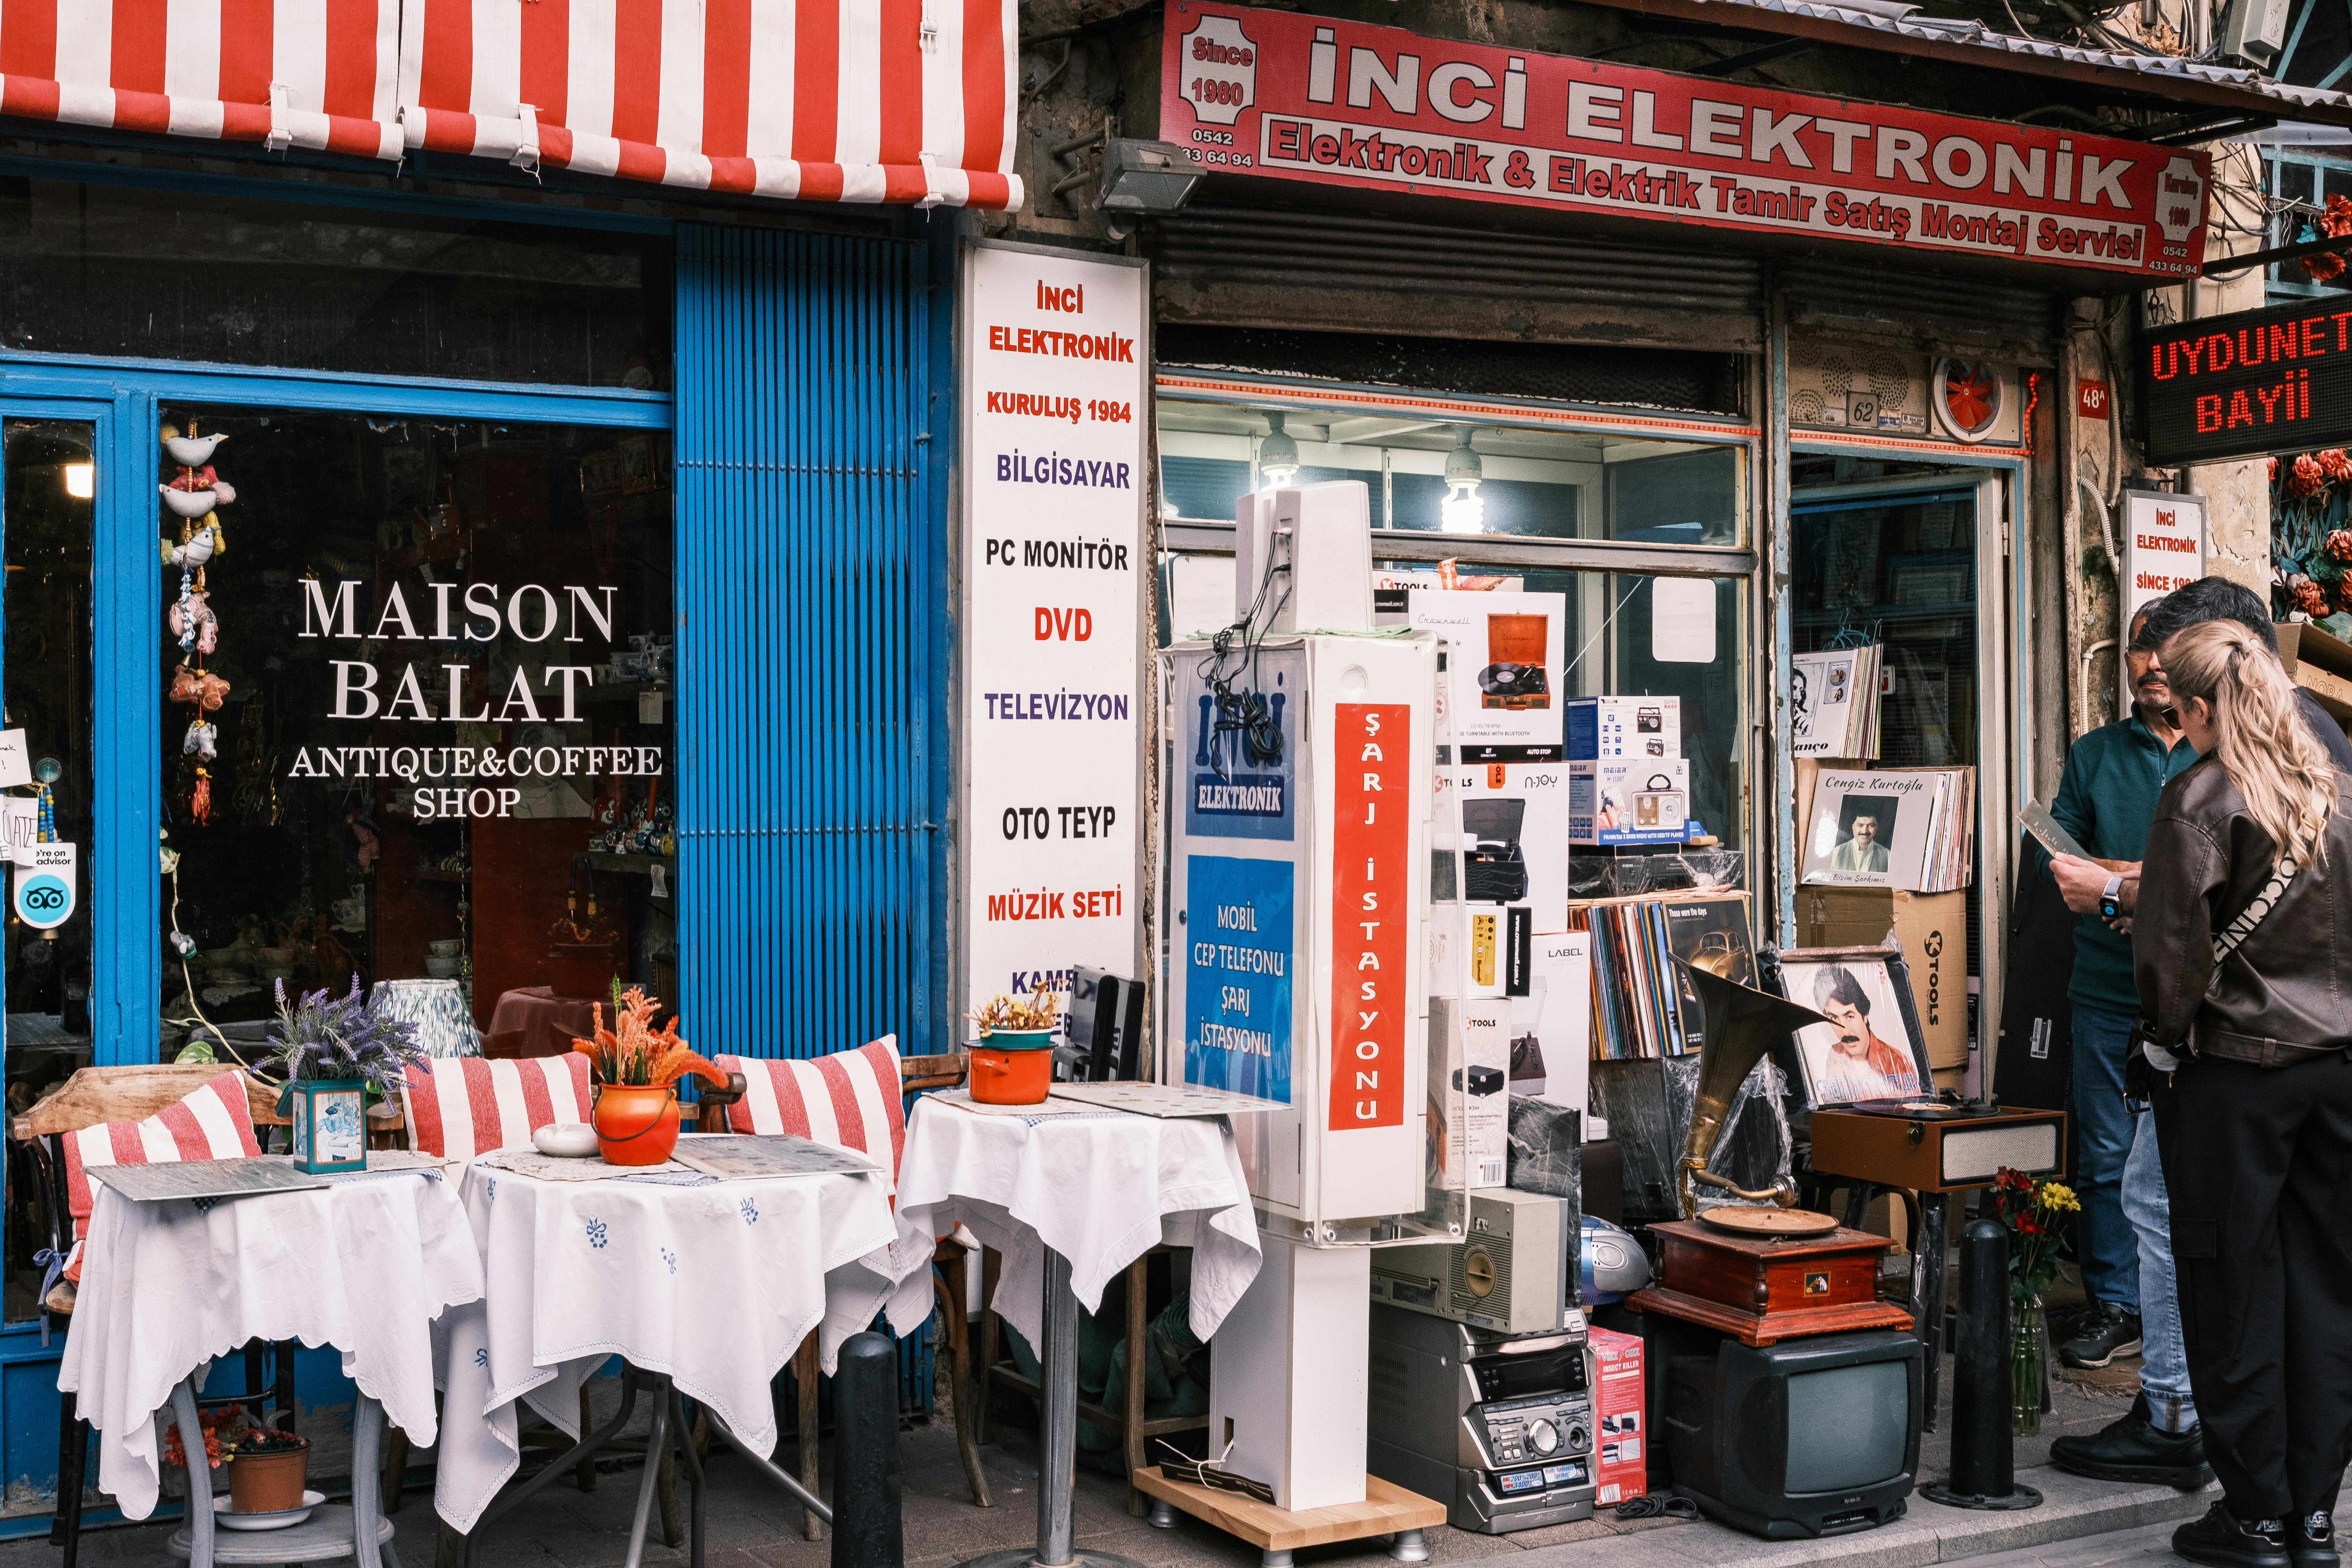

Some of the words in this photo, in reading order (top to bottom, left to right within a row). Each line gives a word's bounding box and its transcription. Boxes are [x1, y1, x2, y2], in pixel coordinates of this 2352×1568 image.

[1193, 36, 1253, 67] Since
[1191, 77, 1243, 106] 1980
[1308, 26, 1527, 130] İNCİ
[1566, 79, 2136, 210] ELEKTRONİK
[1191, 128, 1234, 146] 0542
[1177, 146, 1202, 162] 33
[1206, 150, 1228, 165] 64
[1231, 152, 1253, 167] 94
[1269, 120, 1494, 185] Elektronik
[1503, 150, 1535, 190] &
[1548, 155, 1704, 211] Elektrik
[1710, 175, 1818, 223] Tamir
[1823, 194, 1911, 241] Satış
[1921, 203, 2029, 256] Montaj
[2037, 217, 2143, 261] Servisi
[2149, 260, 2167, 271] 433
[2170, 263, 2182, 273] 64
[2185, 265, 2197, 274] 94
[2163, 246, 2187, 257] 0542
[1037, 280, 1083, 313] İNCİ
[990, 325, 1134, 363] ELEKTRONİK
[2153, 311, 2352, 379] UYDUNET
[988, 391, 1081, 424] KURULUŞ
[1088, 400, 1131, 423] 1984
[1854, 402, 1874, 422] 62
[2197, 368, 2309, 433] BAYİİ
[997, 449, 1130, 489] BİLGİSAYAR
[2156, 508, 2175, 526] İNCİ
[986, 539, 1015, 566] PC
[1024, 536, 1128, 570] MONİTÖR
[2137, 534, 2196, 554] ELEKTRONİK
[2136, 571, 2169, 591] SİNCE
[2173, 577, 2197, 591] 19
[299, 579, 617, 642] MAISON
[1035, 607, 1092, 642] DVD
[327, 660, 593, 723] BALAT
[985, 687, 1128, 720] TELEVİZYON
[288, 746, 662, 782] ANTIQUE&COFFEE
[1794, 742, 1828, 753] anço
[1361, 713, 1384, 825] ŞARJ
[1826, 776, 1865, 792] Cengiz
[1869, 778, 1923, 794] Kurtoğlu
[414, 787, 521, 818] SHOP
[1198, 781, 1281, 811] ELEKTRONİK
[1003, 807, 1050, 840] OTO
[1058, 806, 1116, 839] TEYP
[1854, 875, 1885, 884] Şarkımız
[988, 887, 1065, 921] MÜZİK
[1073, 884, 1122, 918] SETİ
[1218, 900, 1257, 932] MOBİL
[1669, 908, 1681, 917] Those
[1697, 907, 1707, 917] days
[1194, 942, 1215, 967] CEP
[1219, 945, 1283, 977] TELEFONU
[1548, 948, 1583, 957] LABEL
[1222, 985, 1250, 1018] ŞARJ
[1355, 857, 1381, 1119] İSTASYONU
[1929, 958, 1939, 1026] TOOLS
[1200, 1015, 1271, 1058] İSTASYONU
[1603, 1363, 1622, 1373] INSECT
[1623, 1360, 1639, 1370] KILLER
